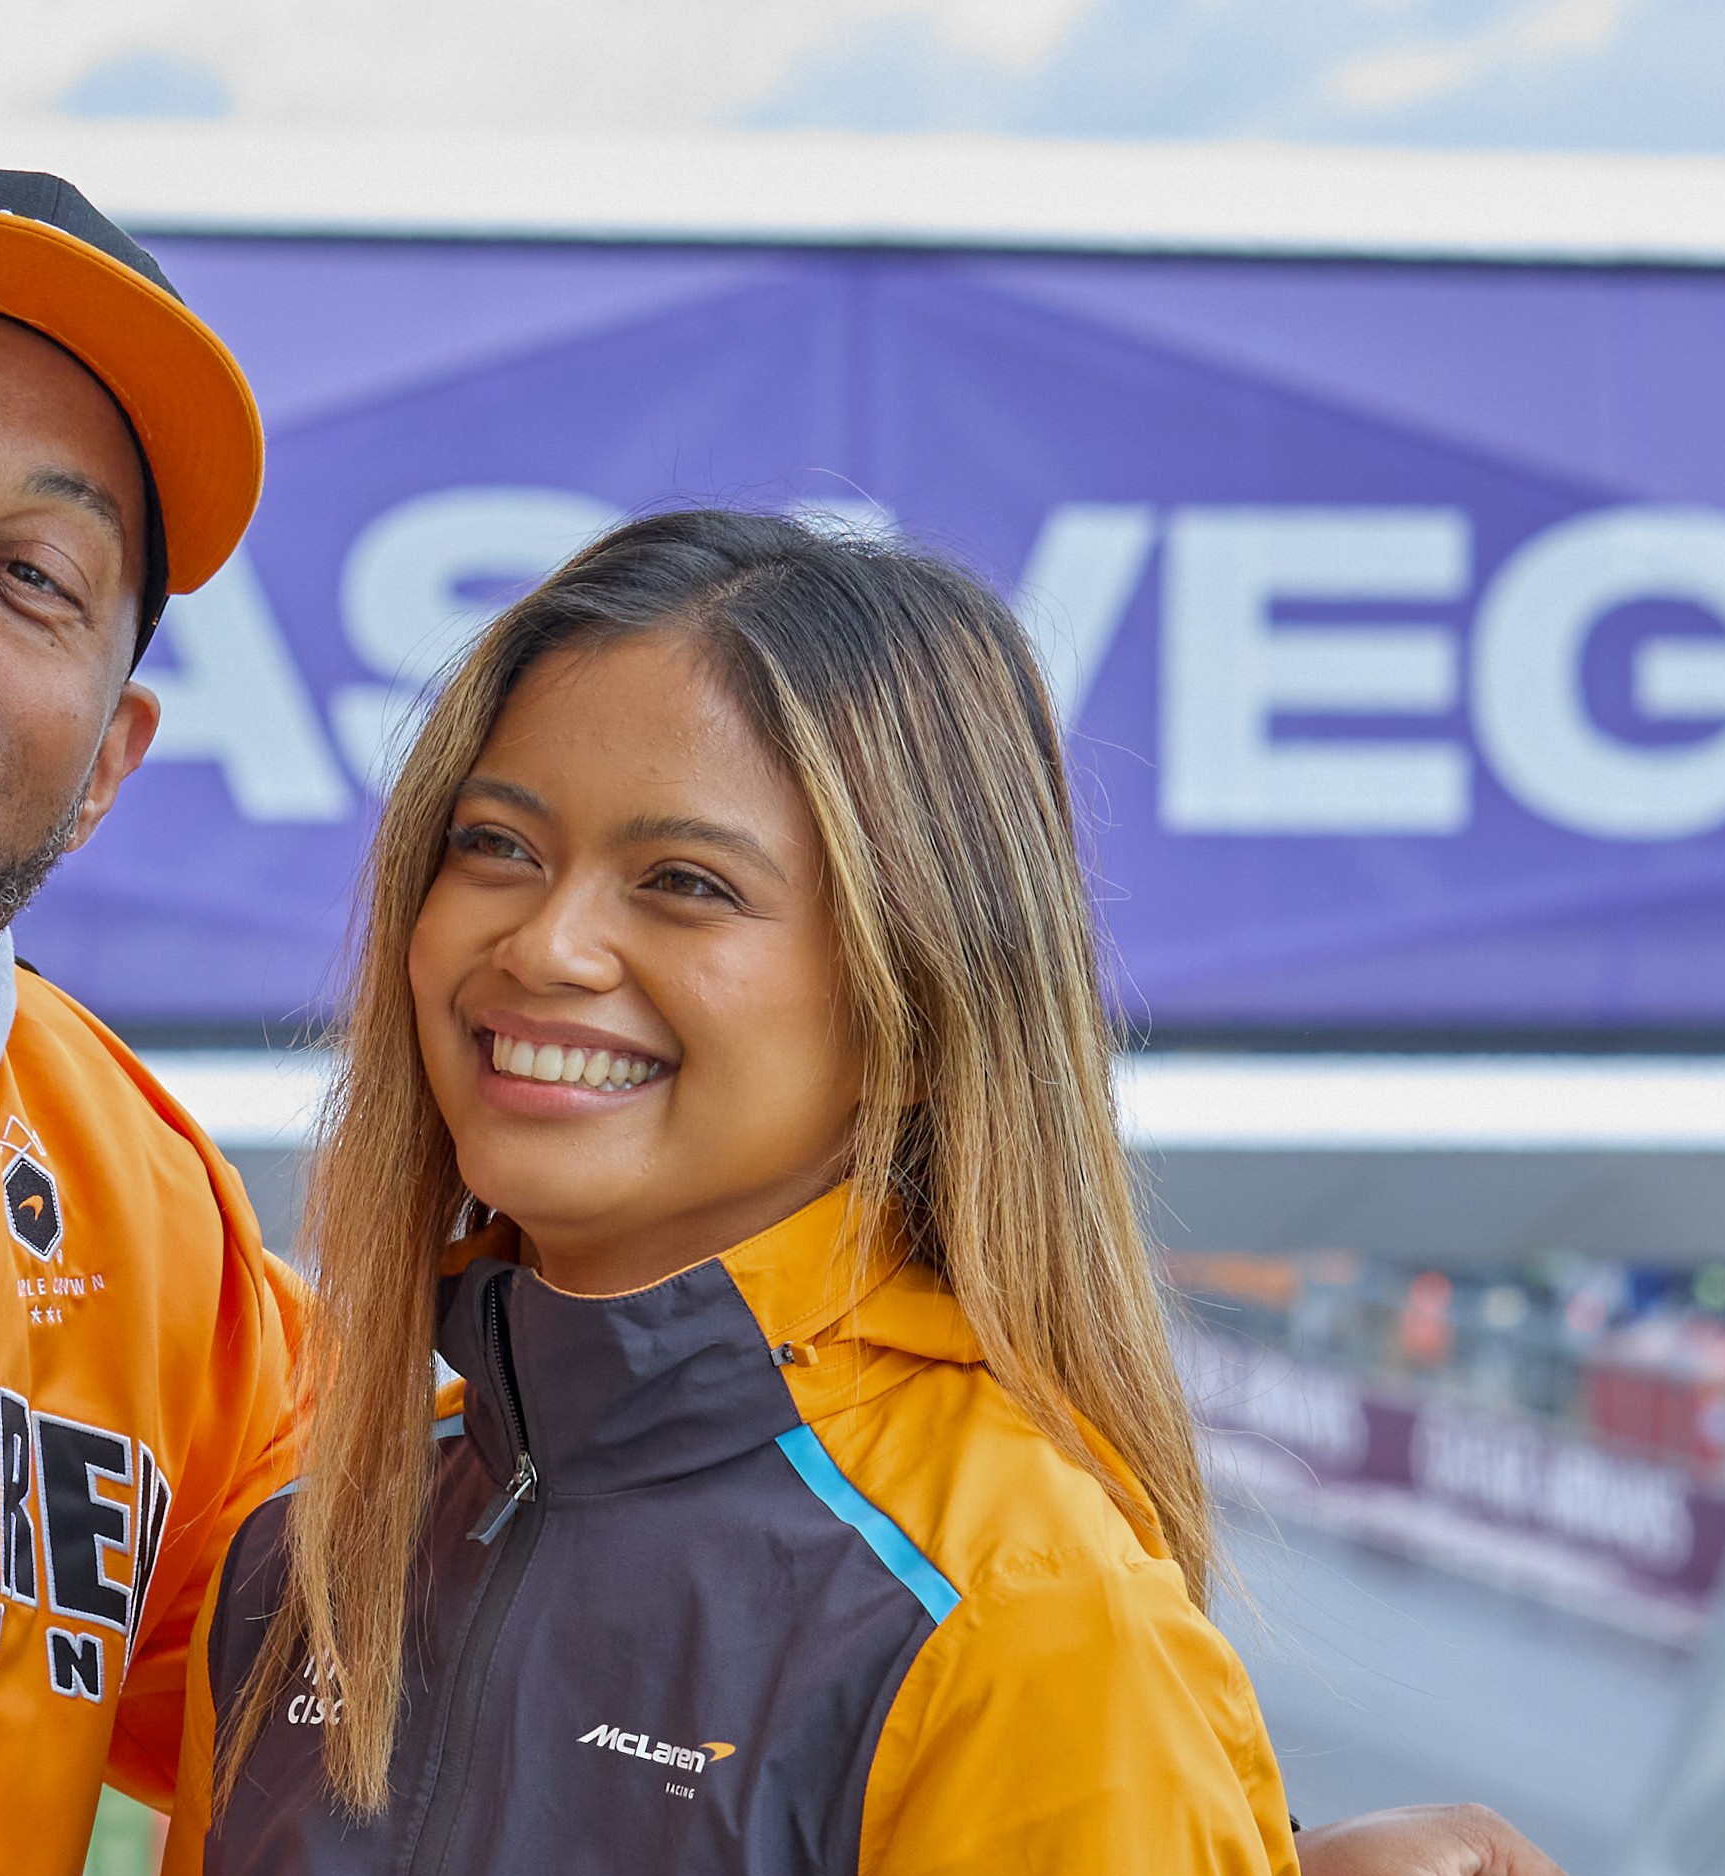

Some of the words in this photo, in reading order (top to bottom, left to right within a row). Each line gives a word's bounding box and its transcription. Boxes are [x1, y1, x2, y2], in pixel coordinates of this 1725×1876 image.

[131, 484, 633, 826] AS
[288, 1694, 344, 1725] CISC
[576, 1724, 706, 1773] McLaren
[665, 1782, 695, 1800] RACING
